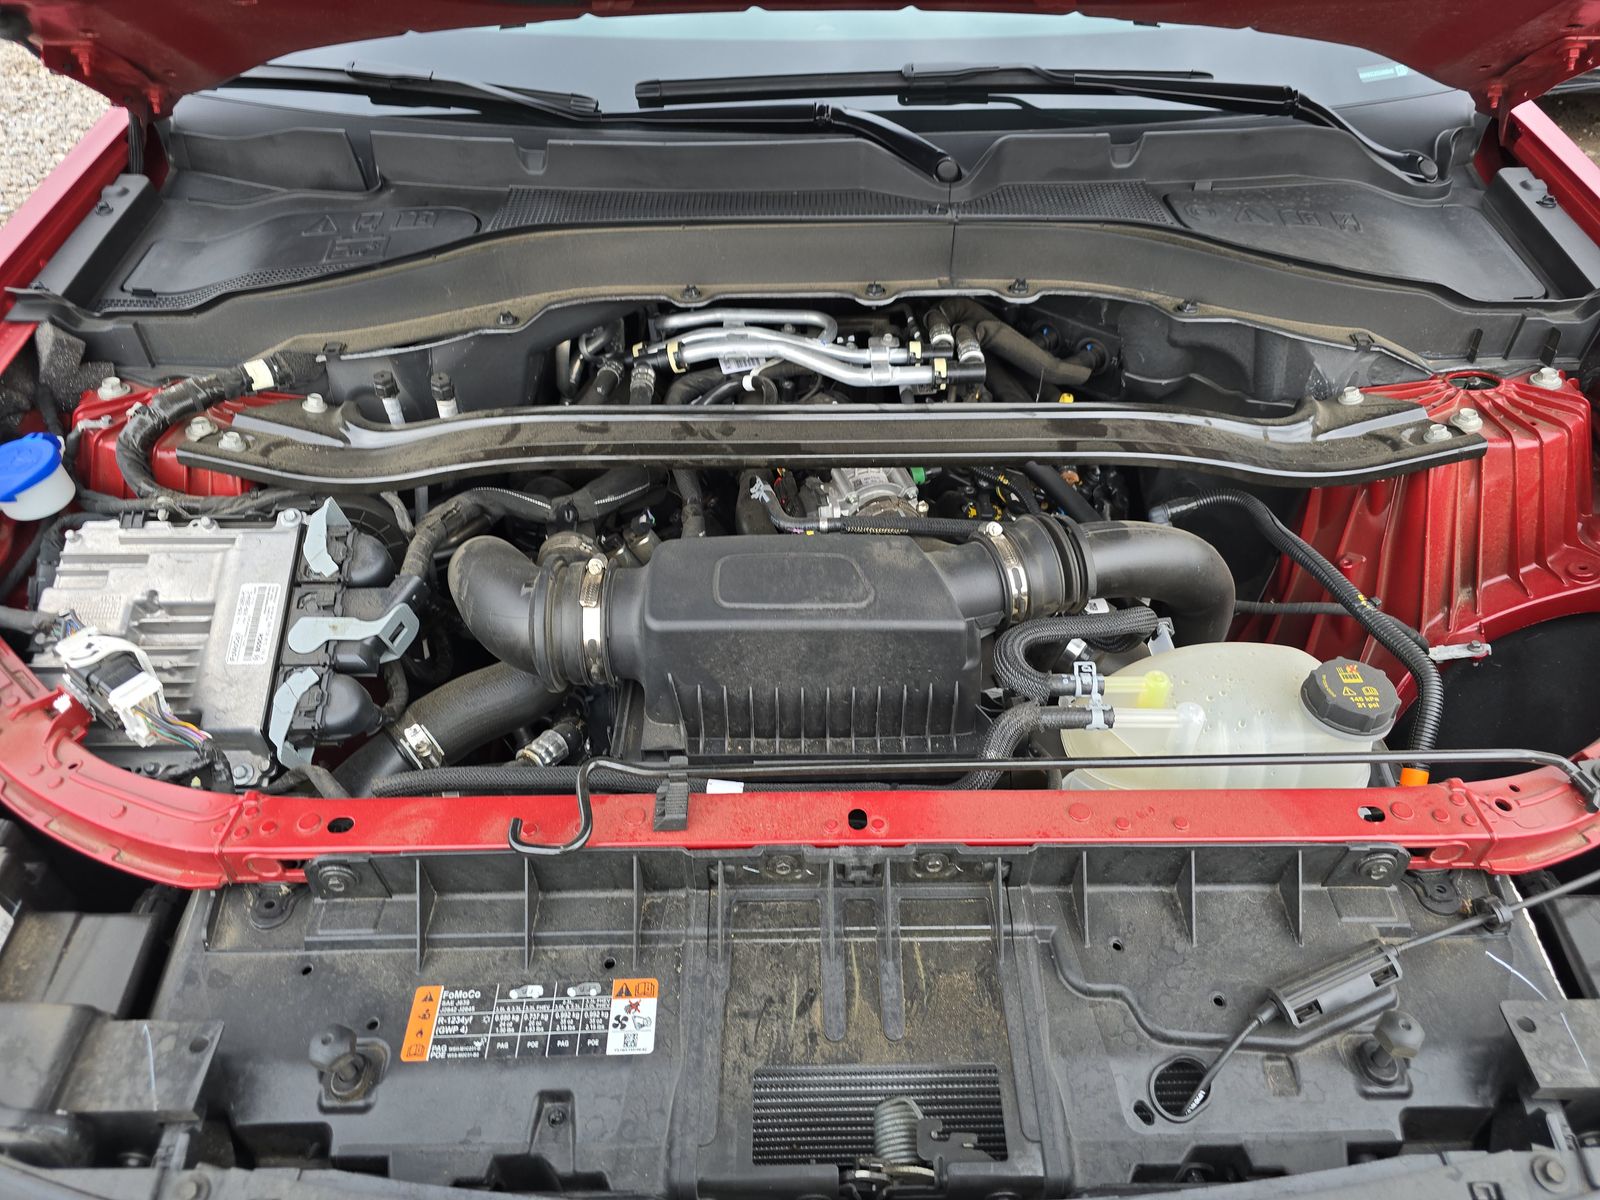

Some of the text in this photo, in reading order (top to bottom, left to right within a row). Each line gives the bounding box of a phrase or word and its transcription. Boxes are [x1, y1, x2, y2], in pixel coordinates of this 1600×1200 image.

[443, 989, 481, 999] FoMoCo
[512, 1014, 520, 1022] kg
[541, 1013, 548, 1022] kg
[572, 1011, 580, 1020] kg
[601, 1011, 609, 1019] kg
[438, 1016, 473, 1025] R-1234yf
[435, 1026, 459, 1035] (GWP
